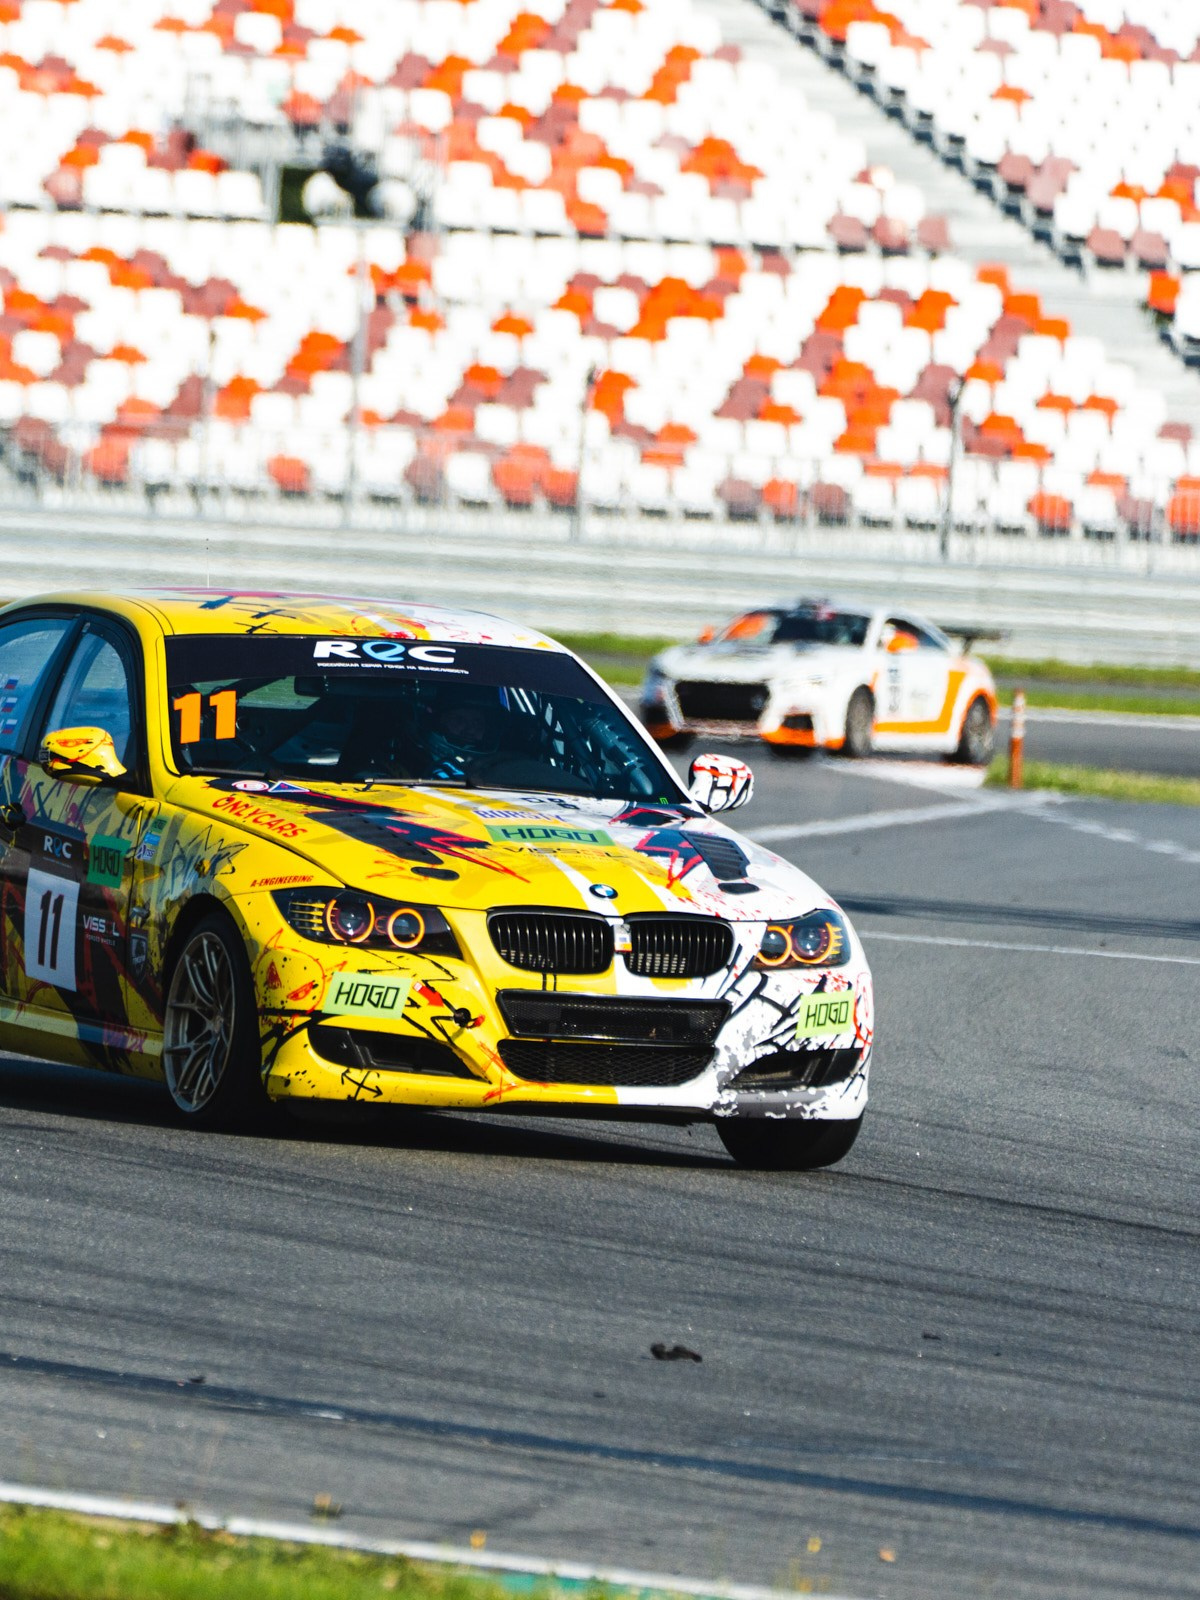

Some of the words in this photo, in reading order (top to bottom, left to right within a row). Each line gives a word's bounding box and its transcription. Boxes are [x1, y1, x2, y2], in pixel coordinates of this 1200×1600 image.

[173, 690, 237, 745] 11
[212, 796, 308, 838] ONLYCARS
[501, 827, 599, 843] HOGO
[92, 844, 121, 877] HOGO
[249, 875, 314, 888] A-ENGINEERING
[37, 889, 64, 971] 11
[82, 914, 120, 937] VISSL
[334, 981, 401, 1010] HOGO
[804, 1000, 849, 1028] HOGO
